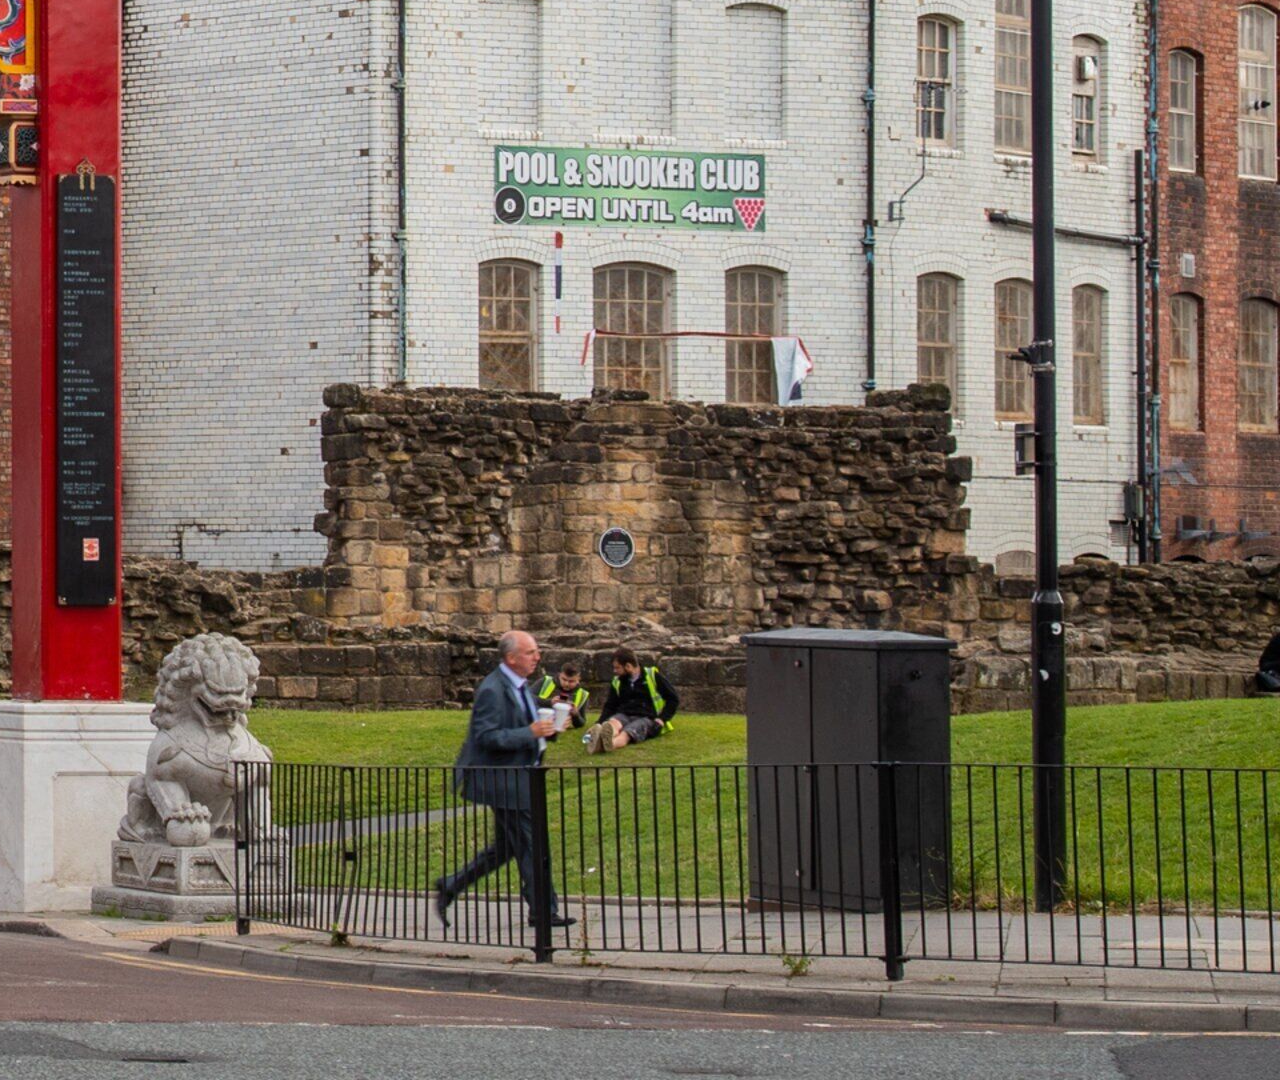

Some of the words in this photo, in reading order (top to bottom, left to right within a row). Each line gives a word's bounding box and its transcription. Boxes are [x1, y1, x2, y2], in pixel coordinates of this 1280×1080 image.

[498, 151, 560, 185] POOL
[563, 157, 583, 187] &
[586, 153, 696, 190] SNOOKER
[699, 158, 761, 192] CLUB
[528, 195, 596, 220] OPEN
[602, 197, 675, 222] UNTIL
[681, 201, 735, 224] 4am
